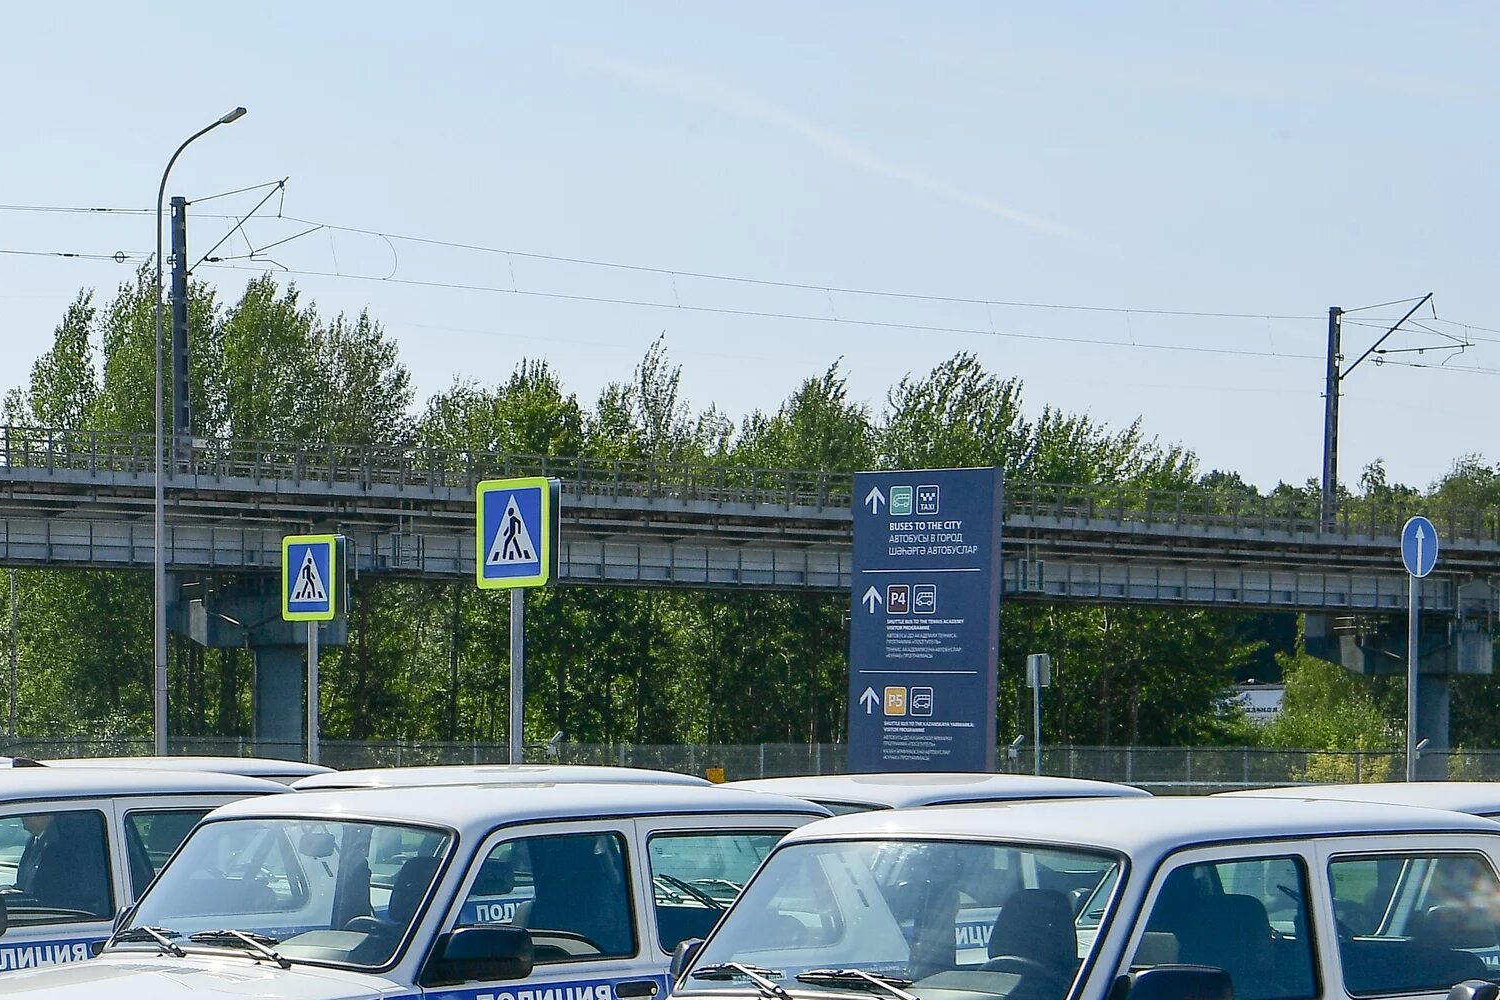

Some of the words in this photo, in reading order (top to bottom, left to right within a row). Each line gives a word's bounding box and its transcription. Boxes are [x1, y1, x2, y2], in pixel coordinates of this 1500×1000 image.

[890, 522, 913, 530] BUSES
[915, 522, 925, 530] TO
[927, 521, 942, 530] THE
[944, 521, 962, 530] CITY
[889, 534, 929, 542] АВТОБУСЫ
[930, 534, 936, 542] В
[937, 533, 963, 542] ГОРОД
[927, 546, 978, 554] АВТОБУСЛАР
[891, 592, 906, 605] P4
[888, 694, 903, 707] P5
[476, 903, 517, 921] ПОЛ
